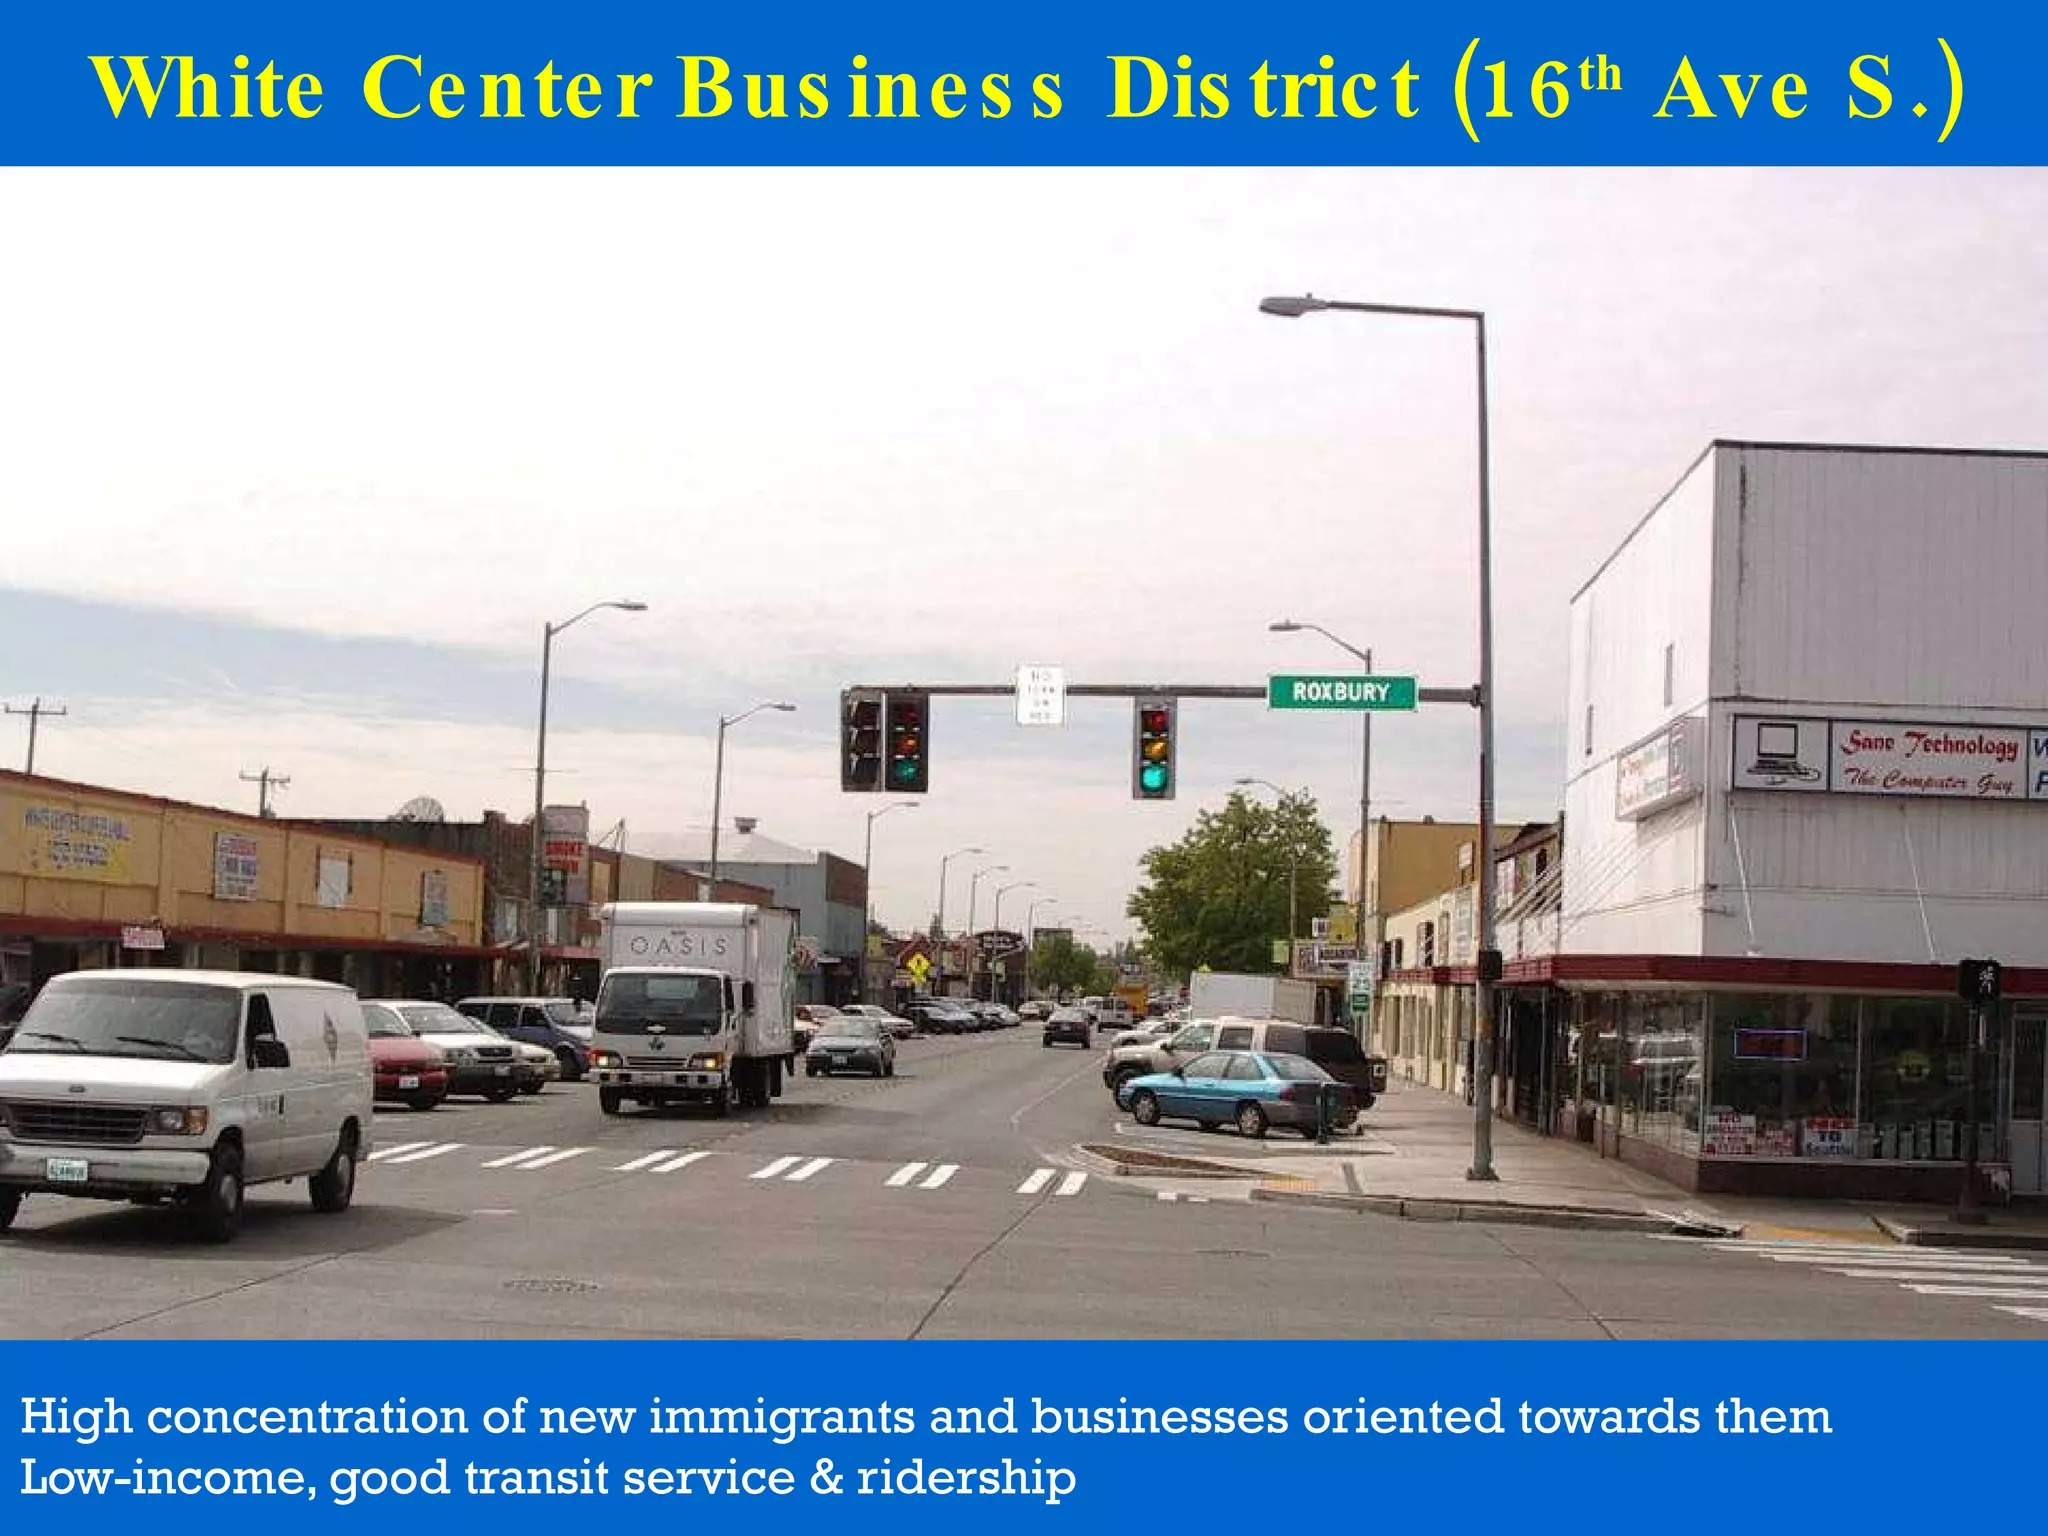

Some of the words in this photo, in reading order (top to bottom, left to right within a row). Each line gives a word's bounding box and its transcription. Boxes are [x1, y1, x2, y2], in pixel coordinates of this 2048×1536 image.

[1292, 682, 1391, 702] ROXBURY
[1842, 729, 1895, 754] Sane
[1905, 731, 2018, 762] Technology
[631, 936, 727, 955] OASIS
